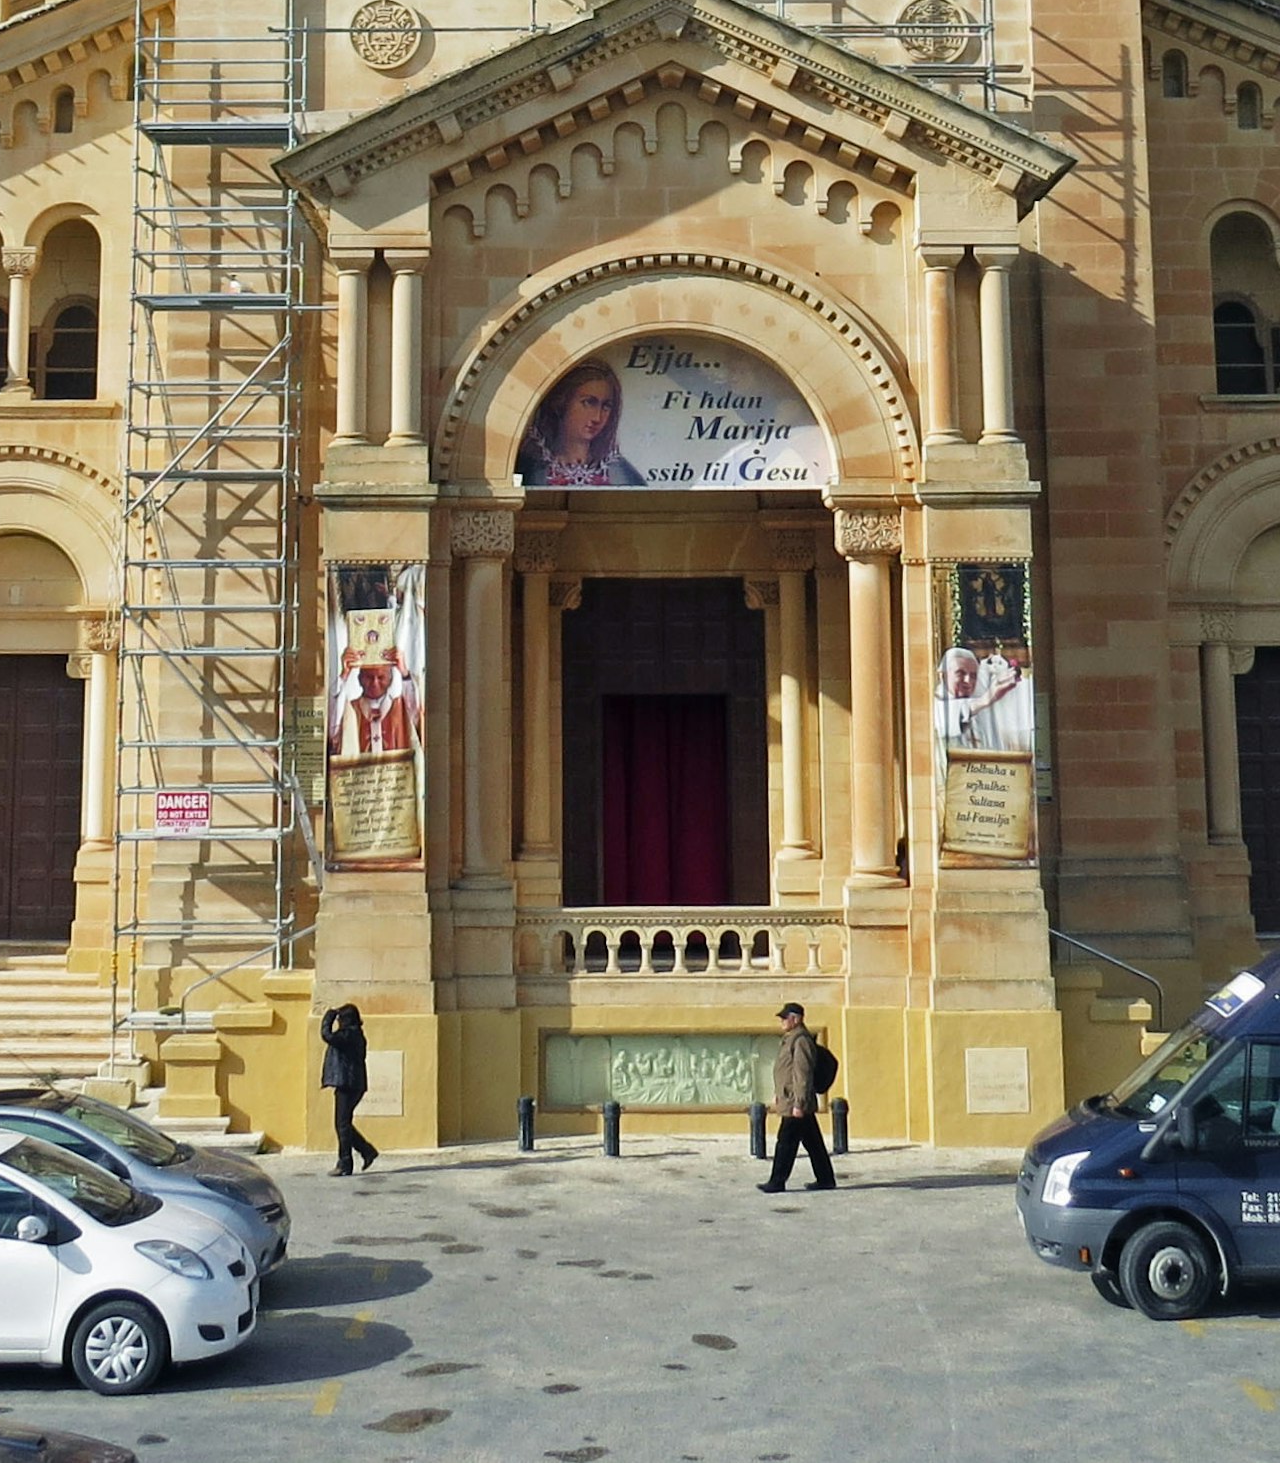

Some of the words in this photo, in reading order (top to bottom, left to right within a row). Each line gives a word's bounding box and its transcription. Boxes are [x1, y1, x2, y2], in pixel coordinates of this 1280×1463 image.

[624, 344, 721, 375] Ejja...
[663, 390, 691, 409] Fi
[685, 415, 792, 446] Marija
[646, 462, 695, 482] ssib
[703, 461, 729, 481] lil
[158, 795, 207, 809] DANGER
[158, 810, 168, 819] DO
[169, 810, 183, 819] NOT
[185, 810, 207, 819] ENTER
[157, 820, 207, 828] CONSTRUCTION
[1242, 1192, 1259, 1202] Tel:
[1242, 1203, 1263, 1213] Fax:
[1242, 1213, 1266, 1222] Mob:
